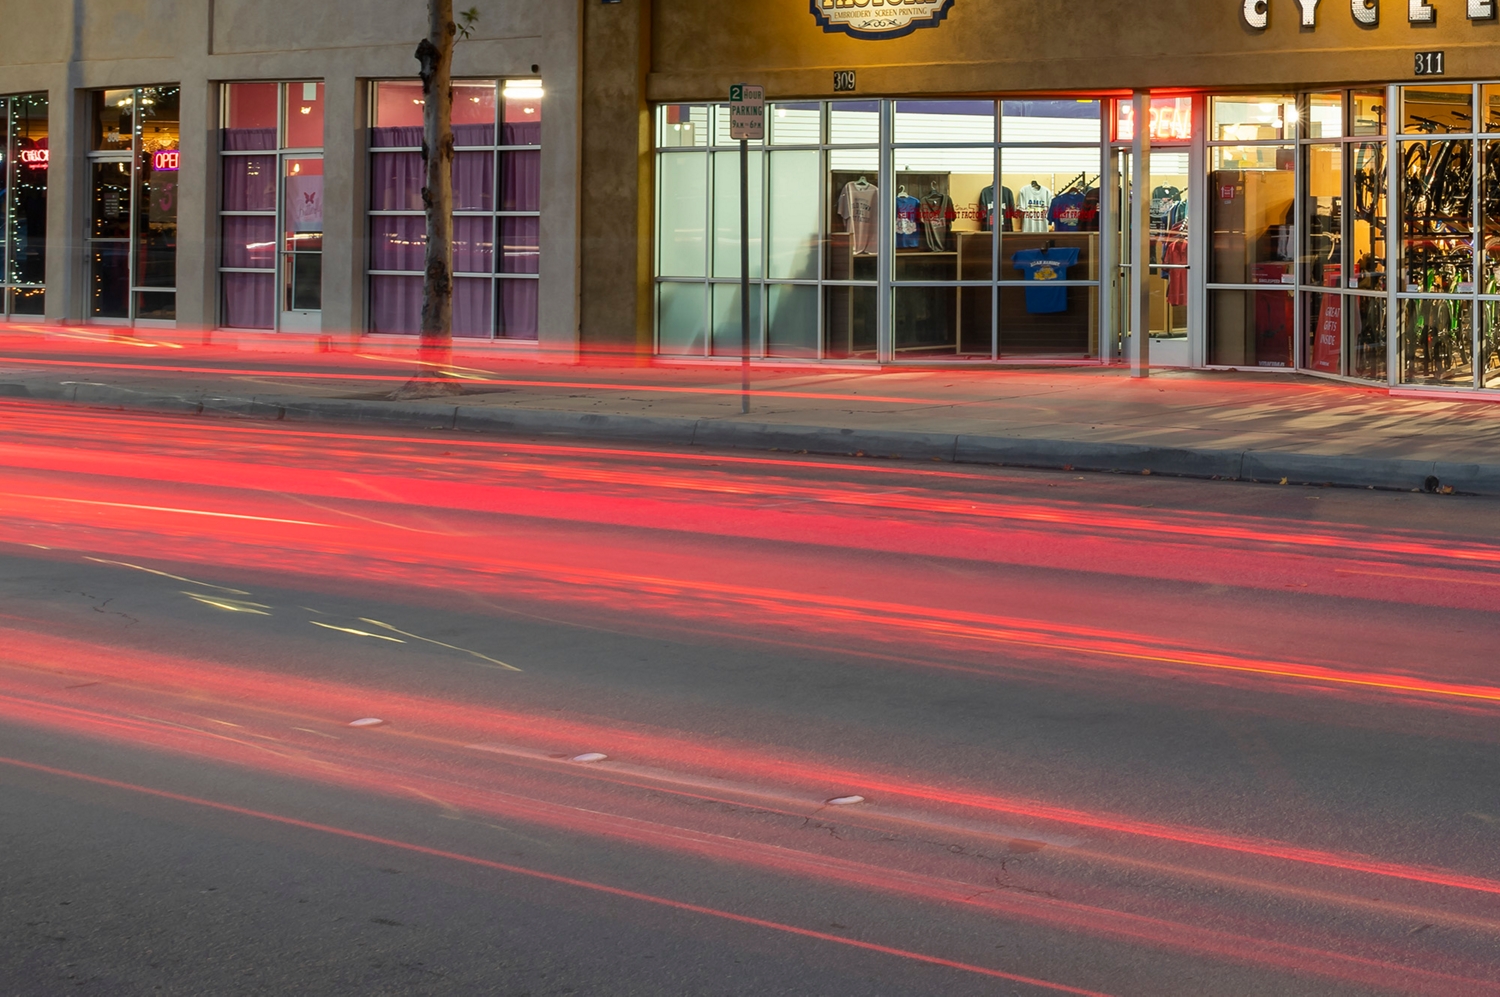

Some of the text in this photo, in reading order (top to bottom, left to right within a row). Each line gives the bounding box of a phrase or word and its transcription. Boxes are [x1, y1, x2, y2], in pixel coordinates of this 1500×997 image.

[834, 6, 928, 19] EMBROIDERY SCREEN PRINTING
[1415, 52, 1443, 73] 311
[834, 71, 855, 90] 309
[731, 87, 762, 99] 2 HOUR
[731, 105, 763, 116] PARKING
[1325, 306, 1340, 318] GREAT
[1323, 320, 1337, 331] GIFTS
[1320, 334, 1336, 346] INSIDE
